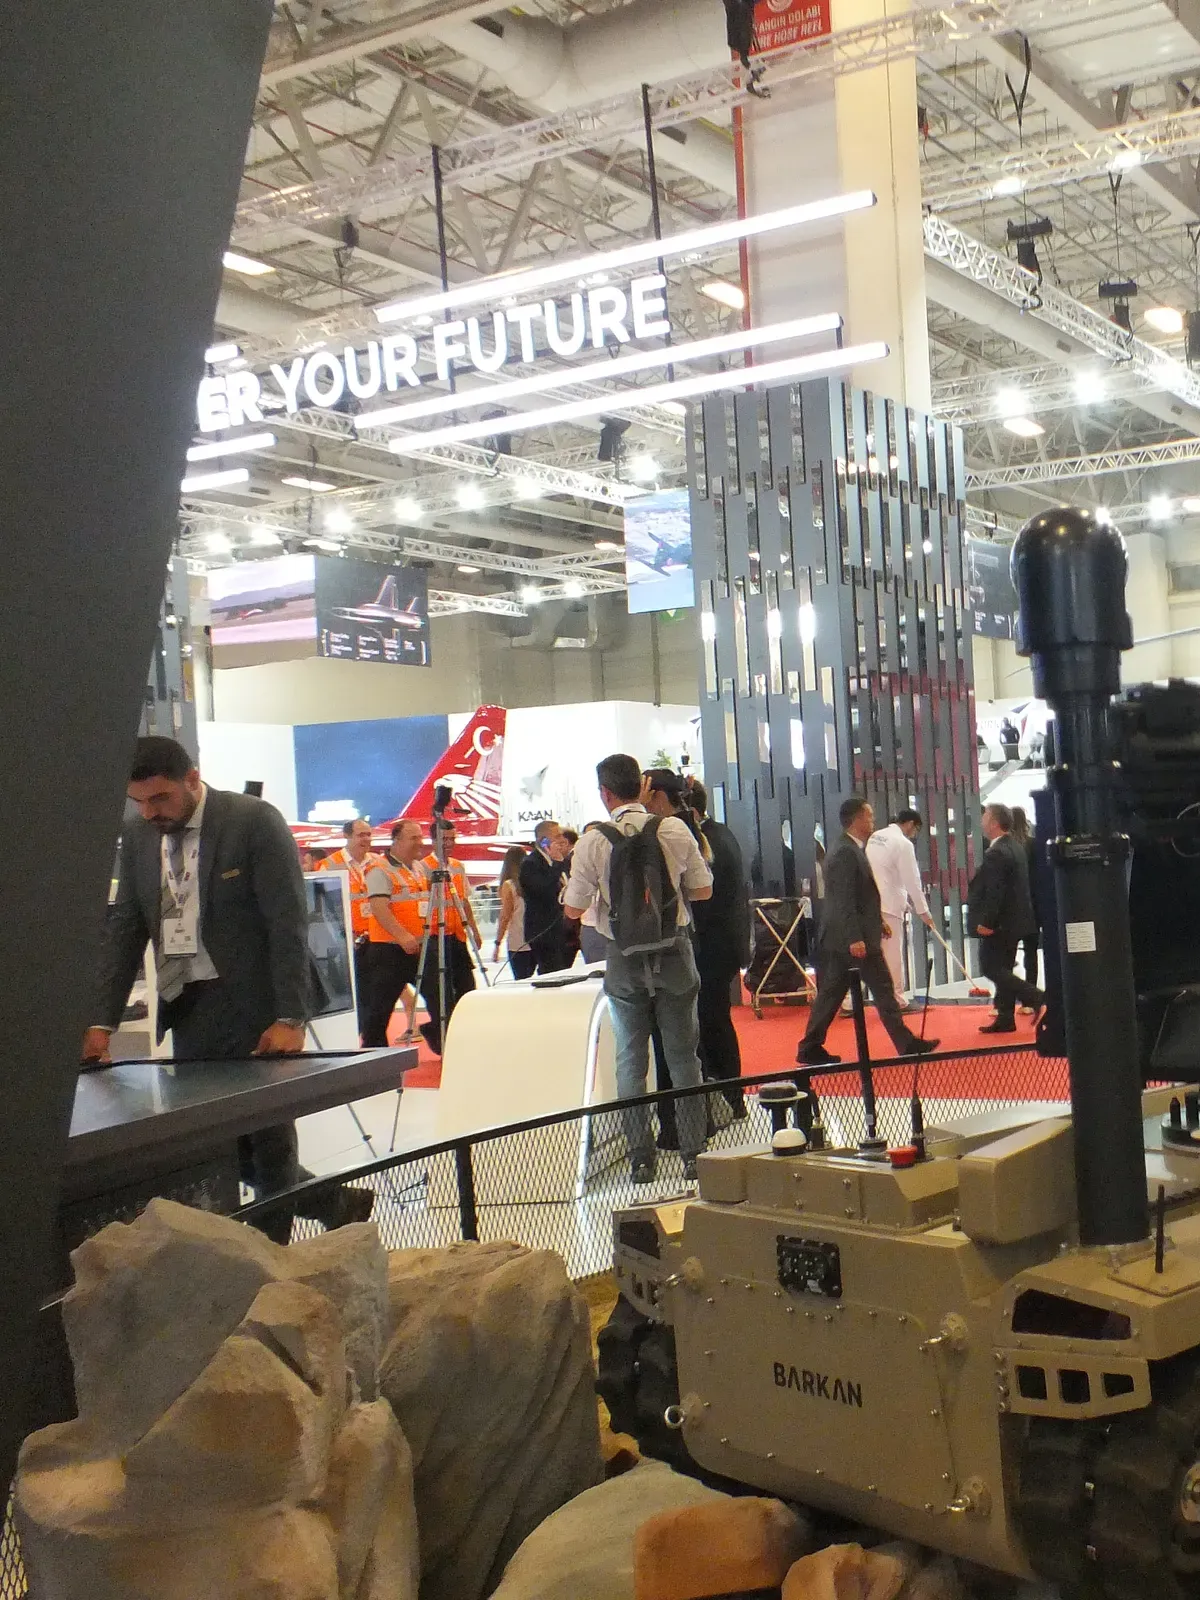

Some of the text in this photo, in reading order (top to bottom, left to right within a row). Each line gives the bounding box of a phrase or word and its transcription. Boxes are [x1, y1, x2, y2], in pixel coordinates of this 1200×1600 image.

[269, 333, 421, 414] YOUR
[432, 274, 671, 381] FUTURE
[773, 1362, 863, 1408] BARKAN
